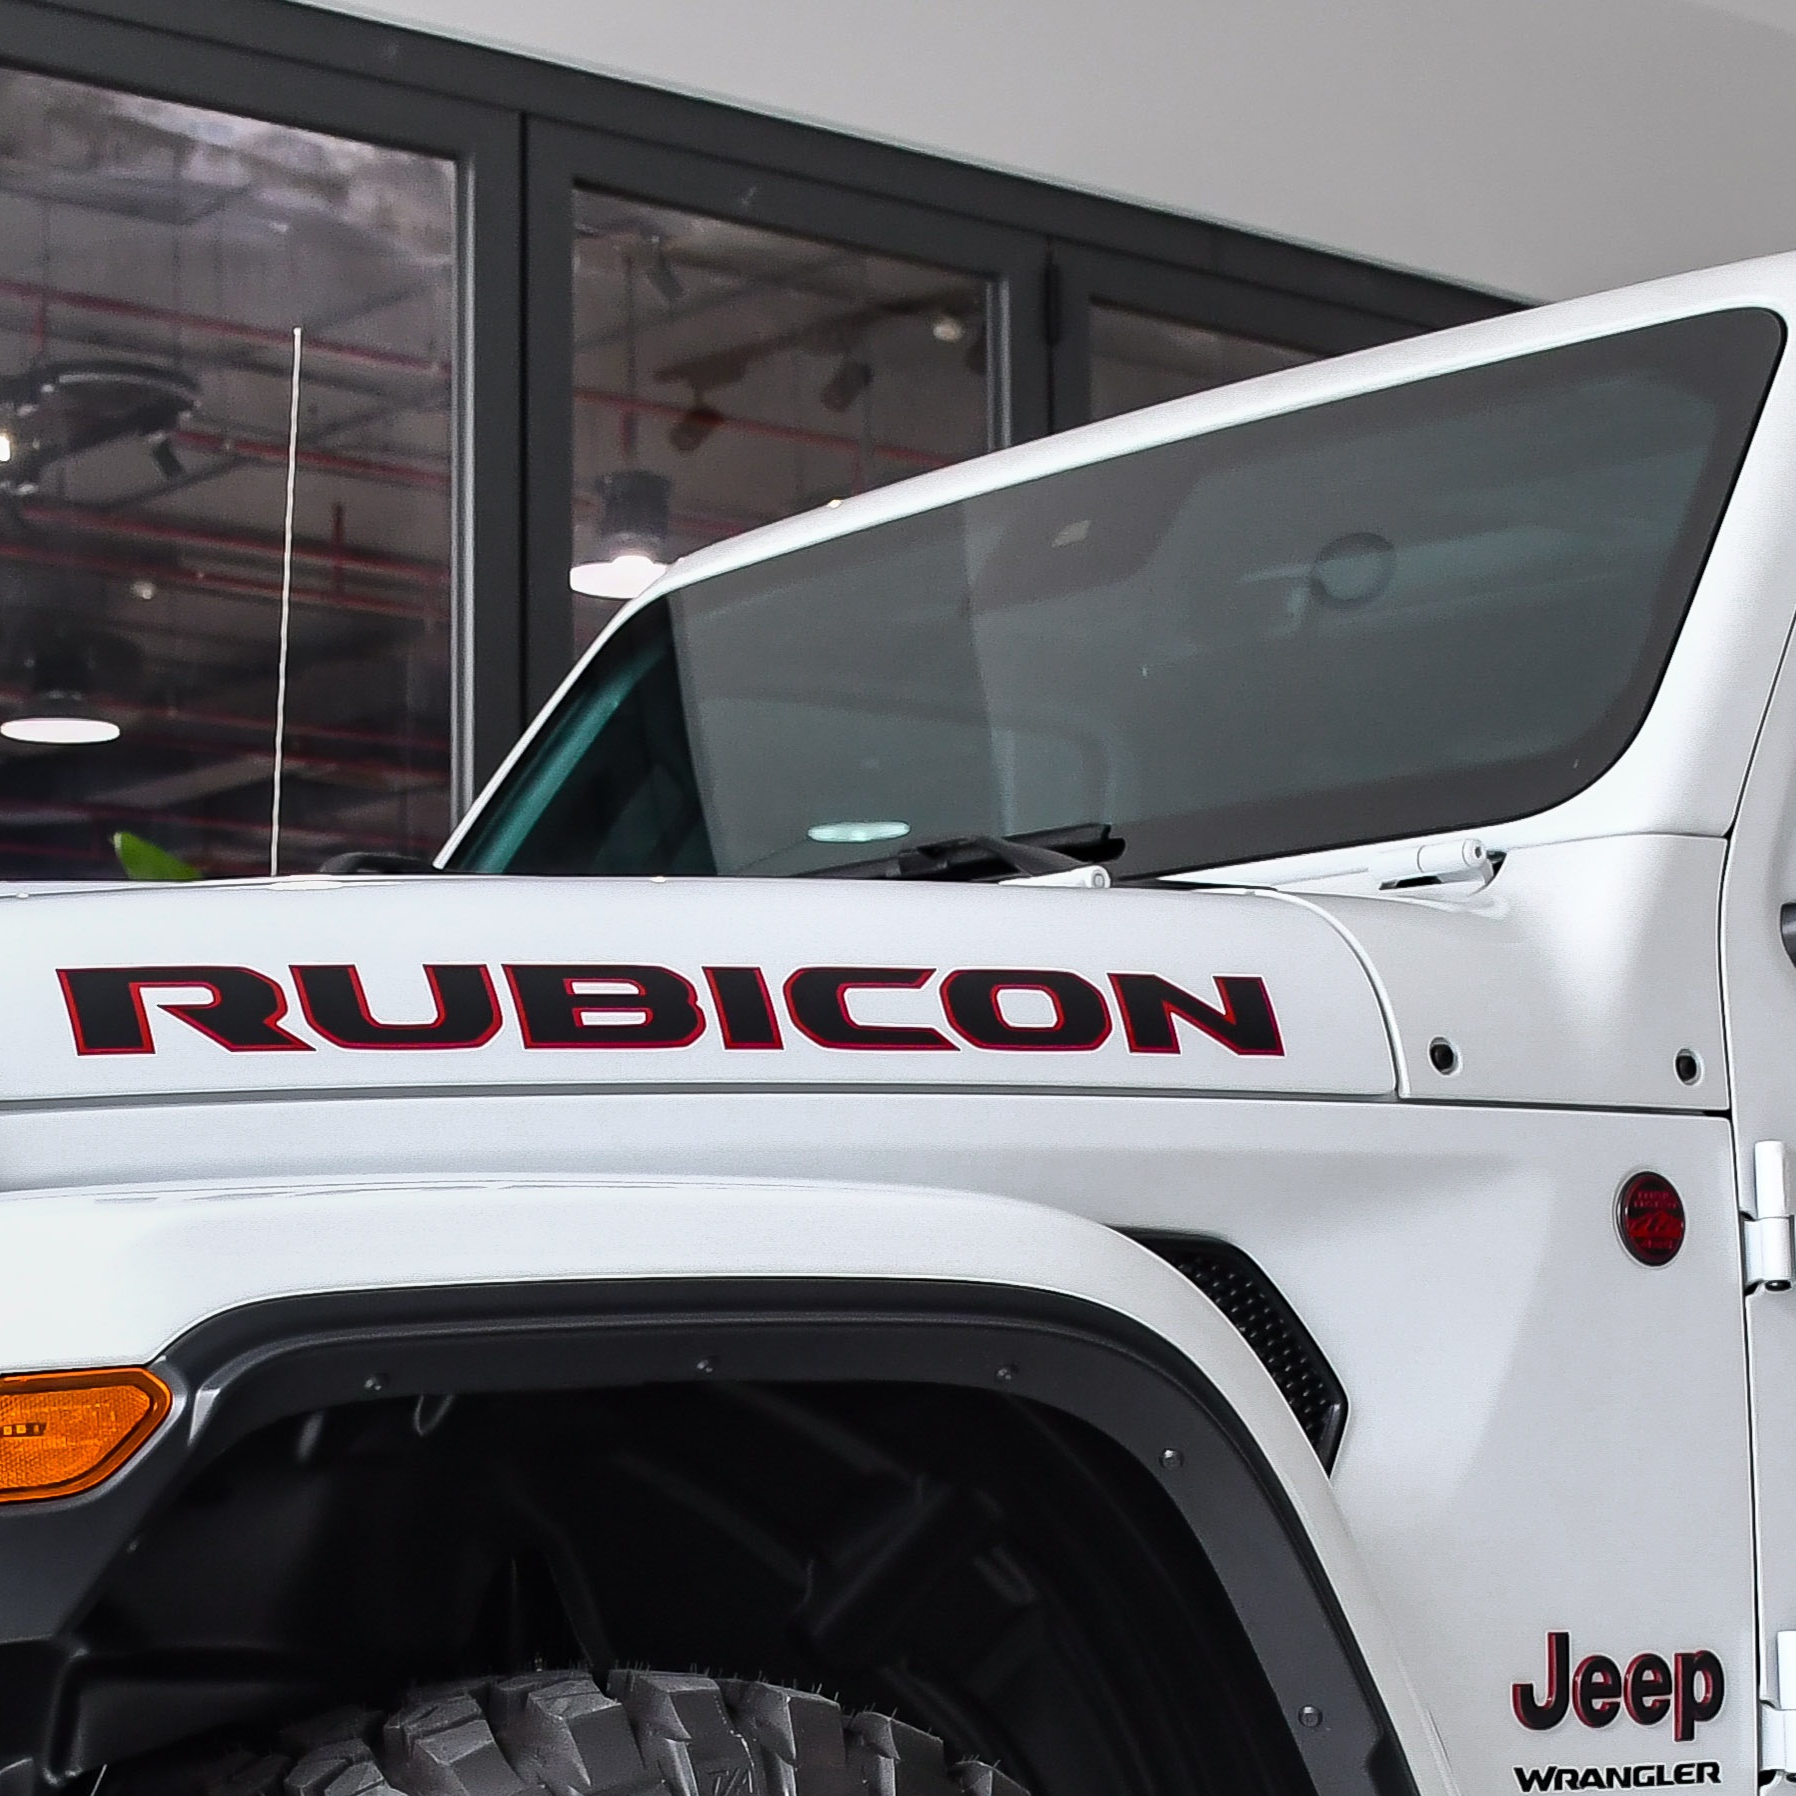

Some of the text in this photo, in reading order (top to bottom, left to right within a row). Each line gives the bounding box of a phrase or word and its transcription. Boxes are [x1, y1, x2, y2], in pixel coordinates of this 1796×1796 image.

[55, 961, 1286, 1058] RUBICON
[1512, 1632, 1725, 1742] Jeep
[1513, 1761, 1722, 1793] WRANGLER
